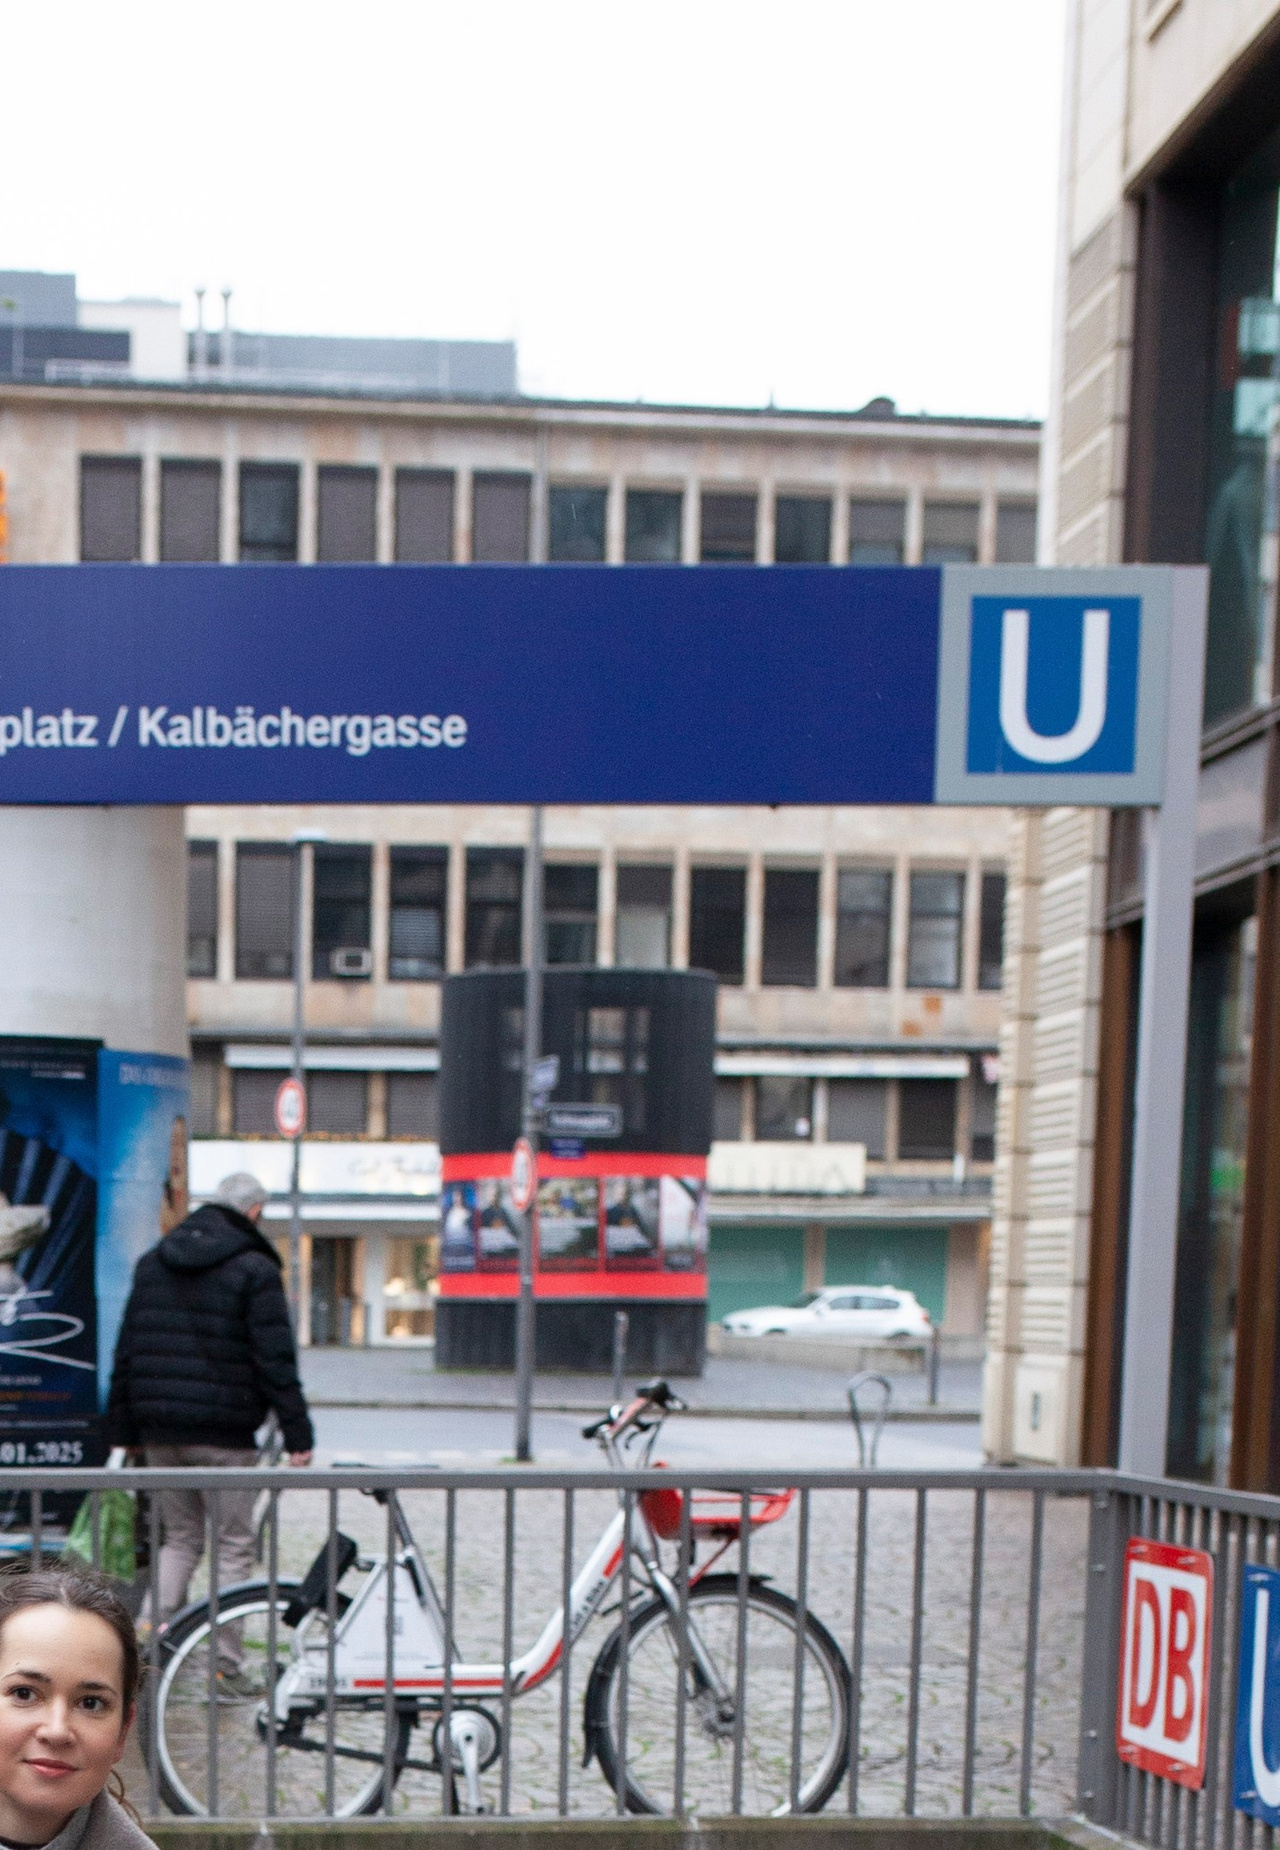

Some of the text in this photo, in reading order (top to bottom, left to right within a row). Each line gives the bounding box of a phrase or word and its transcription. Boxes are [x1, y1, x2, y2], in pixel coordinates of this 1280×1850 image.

[139, 704, 467, 757] Kalbächergasse
[999, 609, 1109, 764] U
[1128, 1577, 1197, 1744] DB
